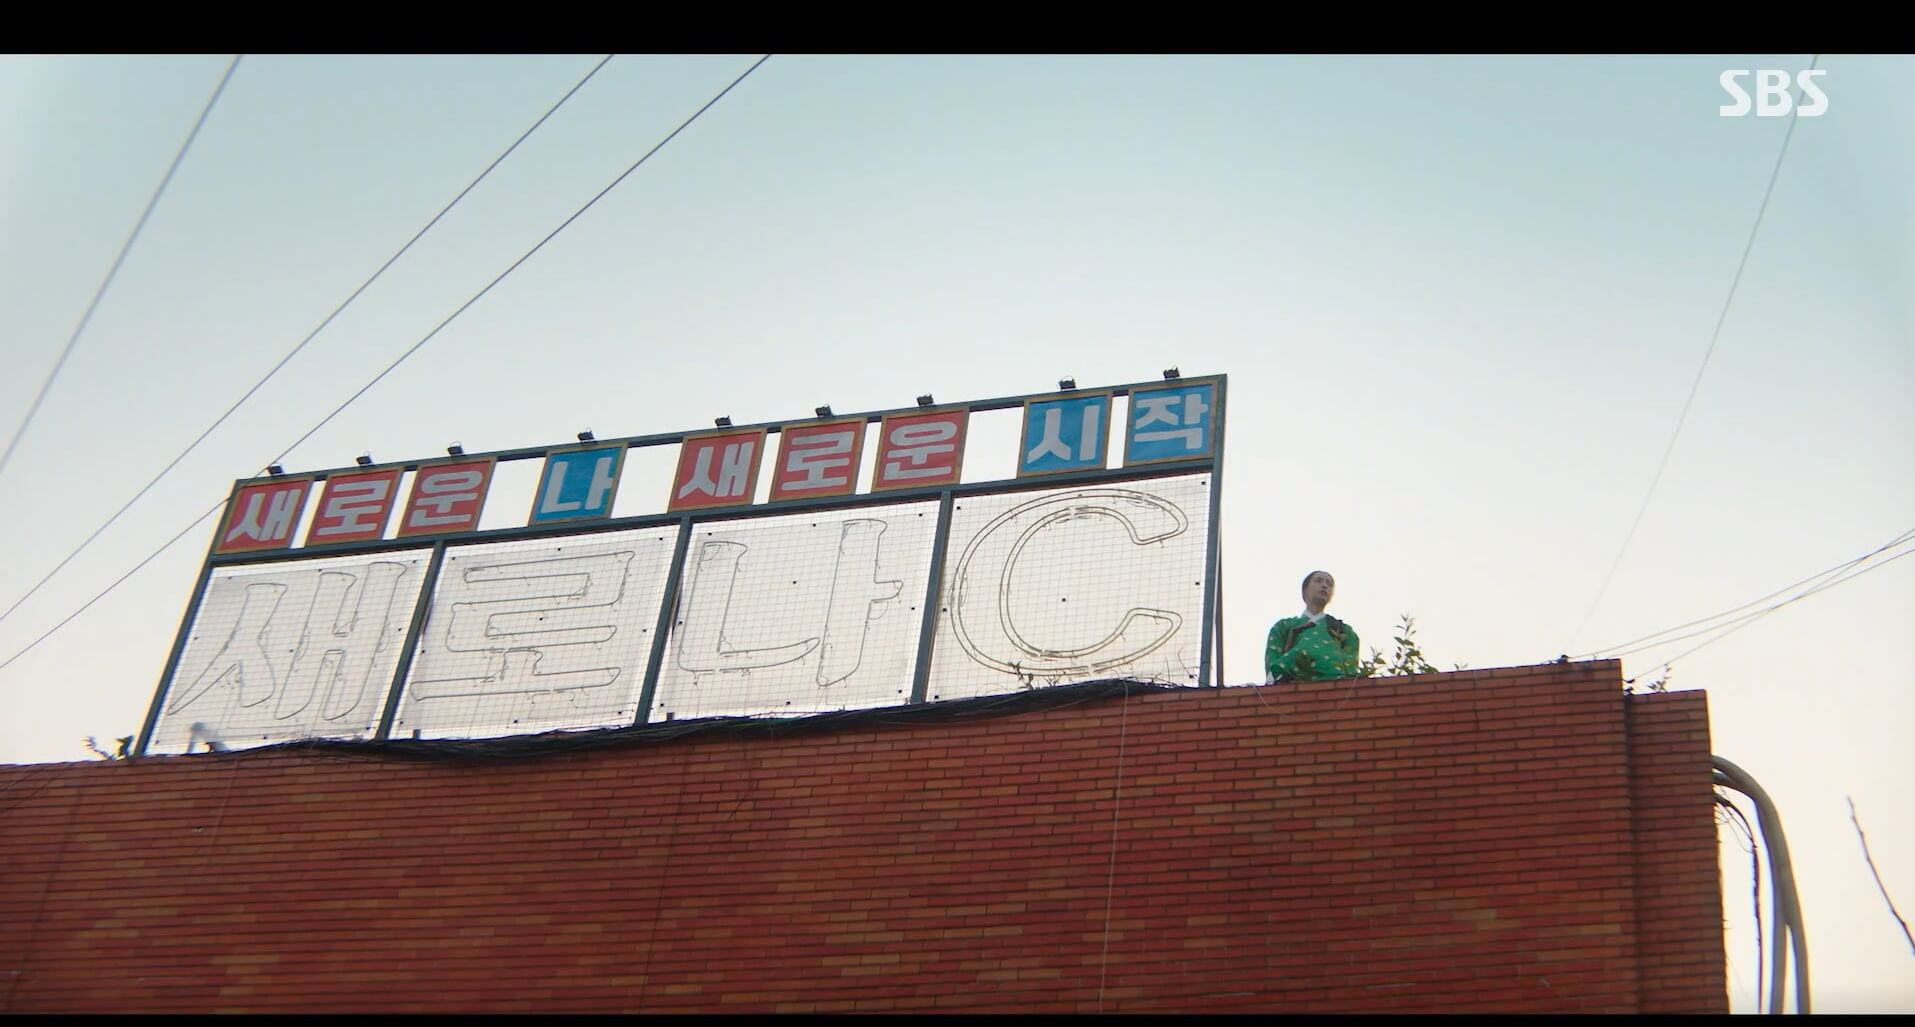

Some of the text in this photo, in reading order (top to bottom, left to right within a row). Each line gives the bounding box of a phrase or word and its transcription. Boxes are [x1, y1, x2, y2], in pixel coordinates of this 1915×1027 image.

[225, 392, 1209, 544] 새로운 나 새로운 시작
